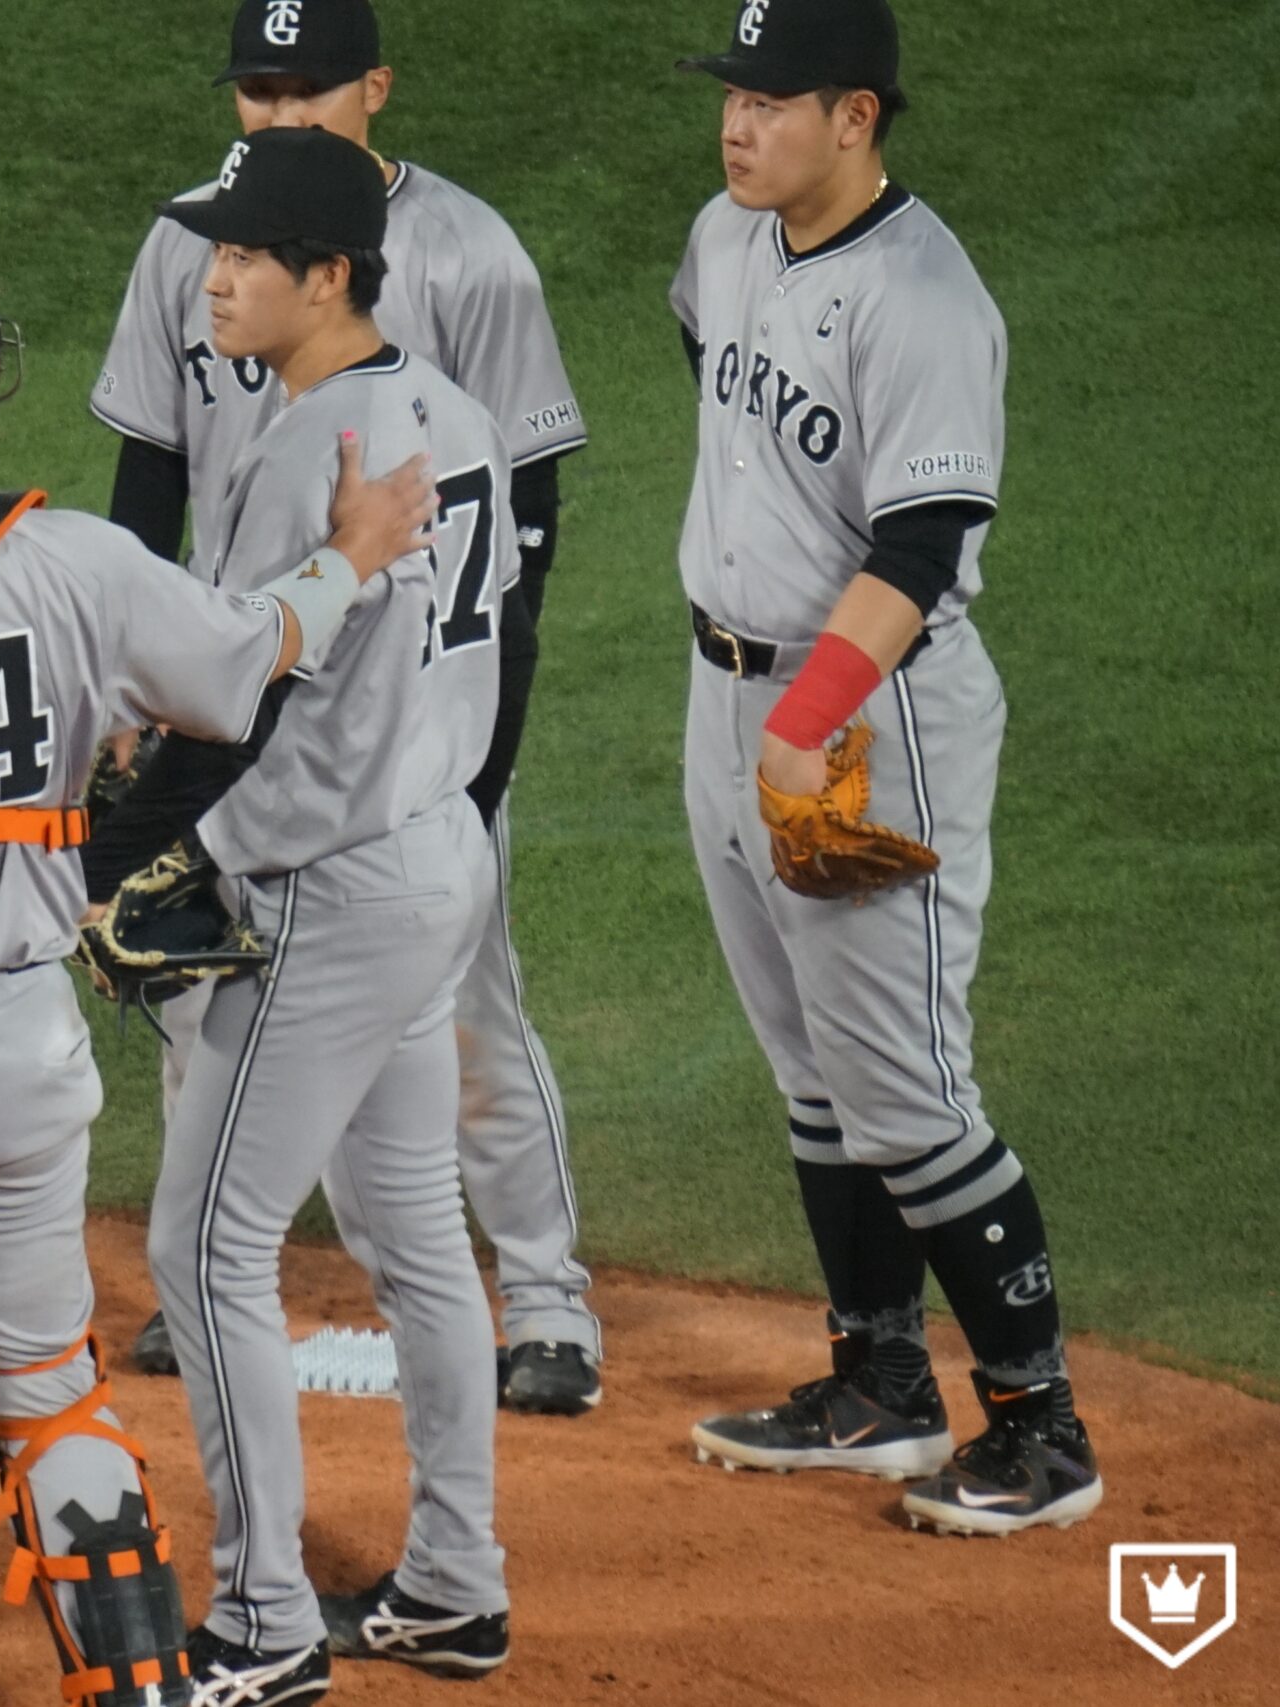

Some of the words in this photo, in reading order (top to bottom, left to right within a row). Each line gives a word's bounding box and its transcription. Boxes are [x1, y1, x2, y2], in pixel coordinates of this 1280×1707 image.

[816, 297, 842, 339] C
[524, 400, 580, 435] YOHI
[698, 337, 844, 468] OKYO
